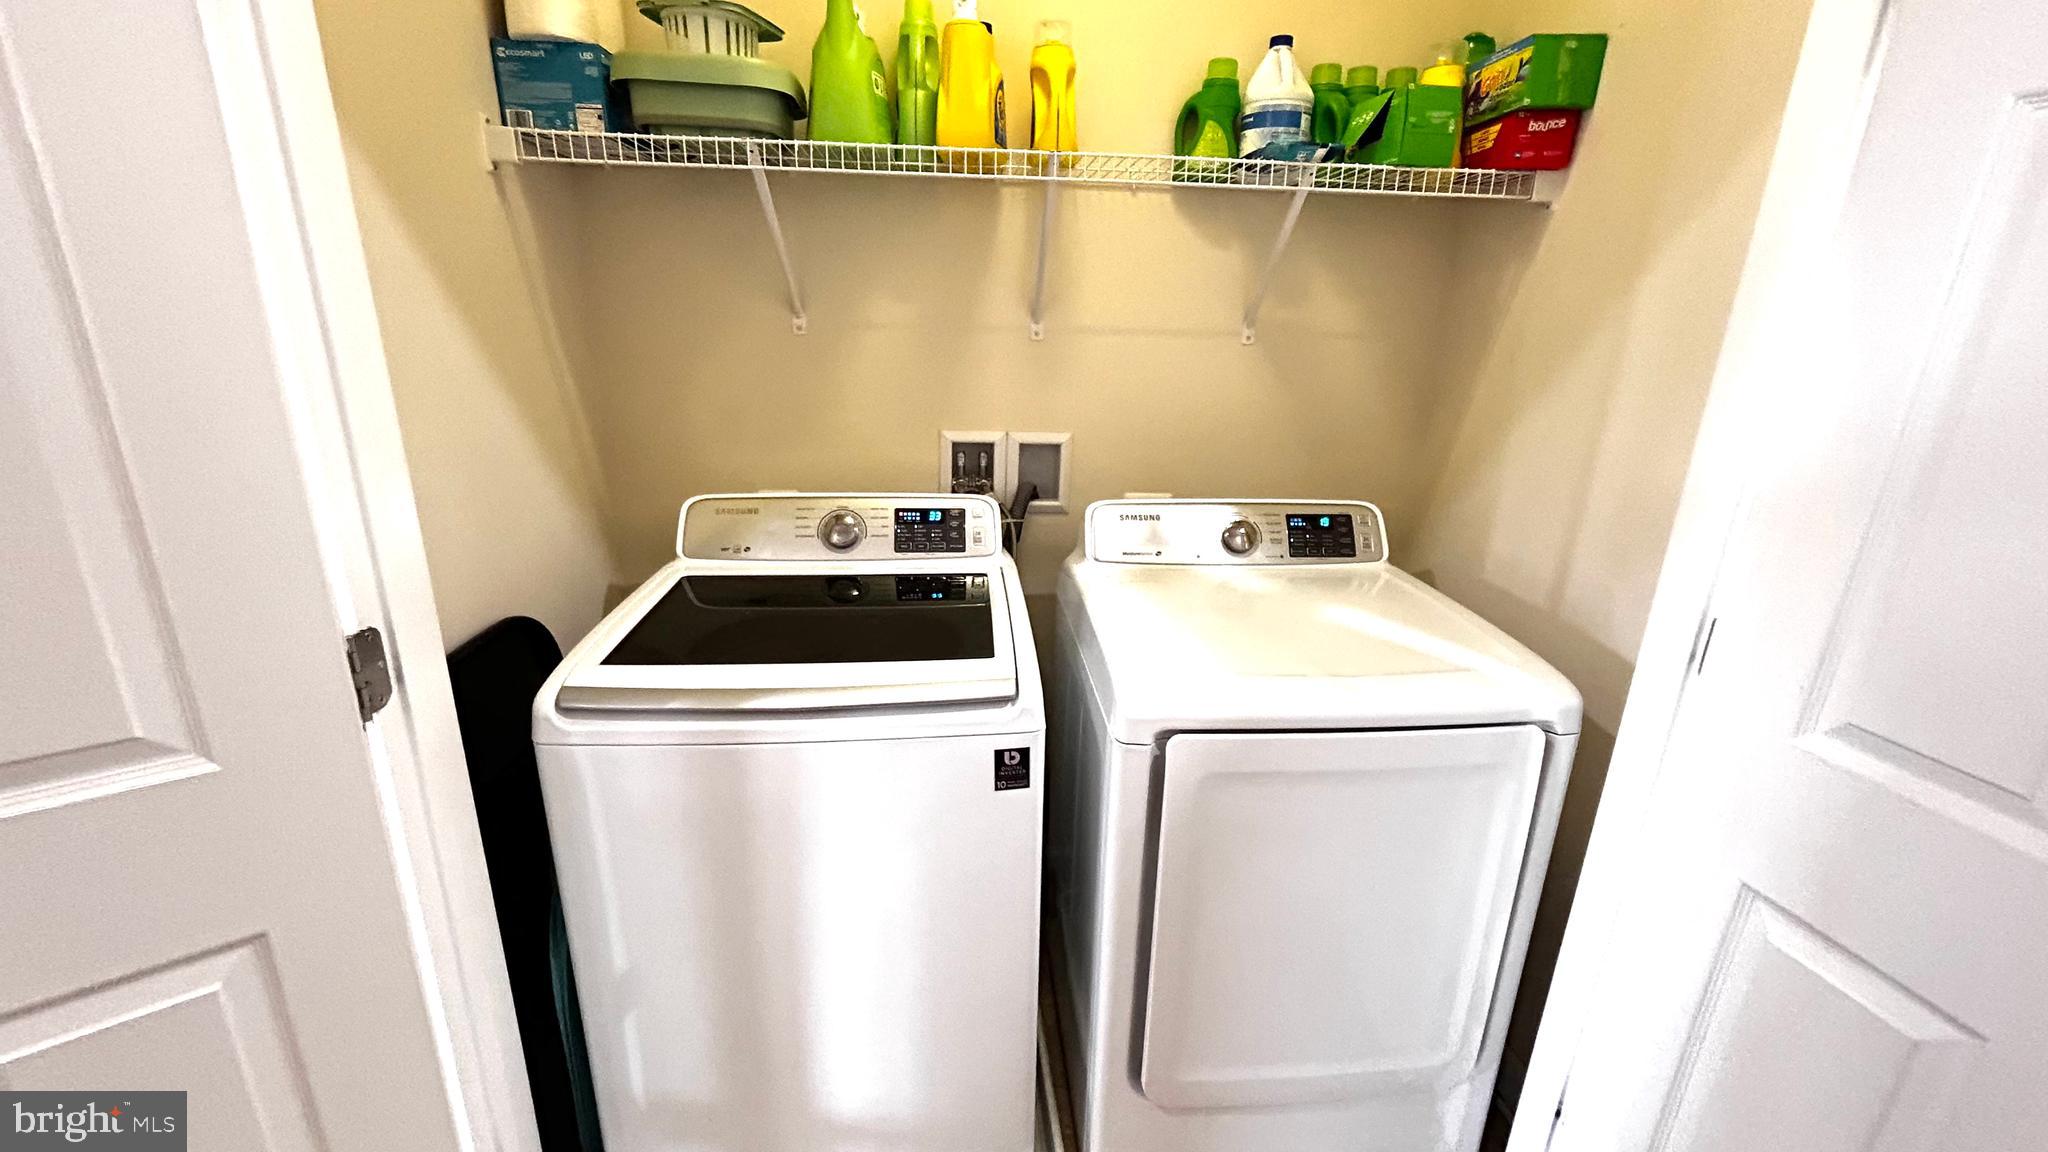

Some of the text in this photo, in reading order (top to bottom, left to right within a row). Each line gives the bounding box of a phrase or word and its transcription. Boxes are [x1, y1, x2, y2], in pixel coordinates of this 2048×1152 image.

[579, 51, 594, 60] LED
[1528, 117, 1567, 132] bounce
[997, 780, 1007, 789] 10
